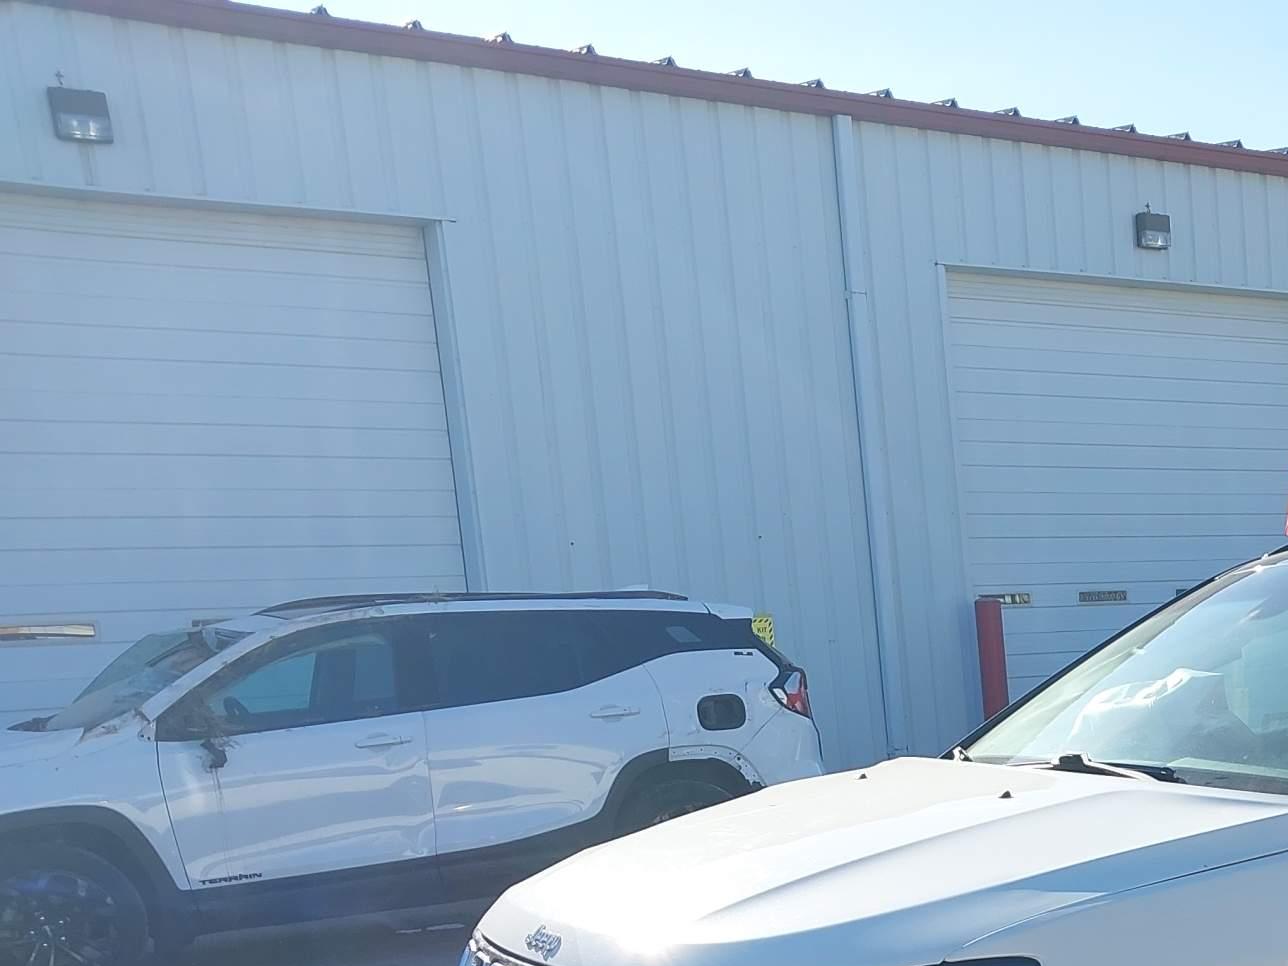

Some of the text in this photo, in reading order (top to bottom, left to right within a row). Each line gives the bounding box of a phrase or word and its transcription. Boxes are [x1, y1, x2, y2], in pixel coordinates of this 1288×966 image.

[757, 626, 768, 634] KIT
[199, 872, 263, 885] TERRAIN
[525, 924, 562, 961] Jeep
